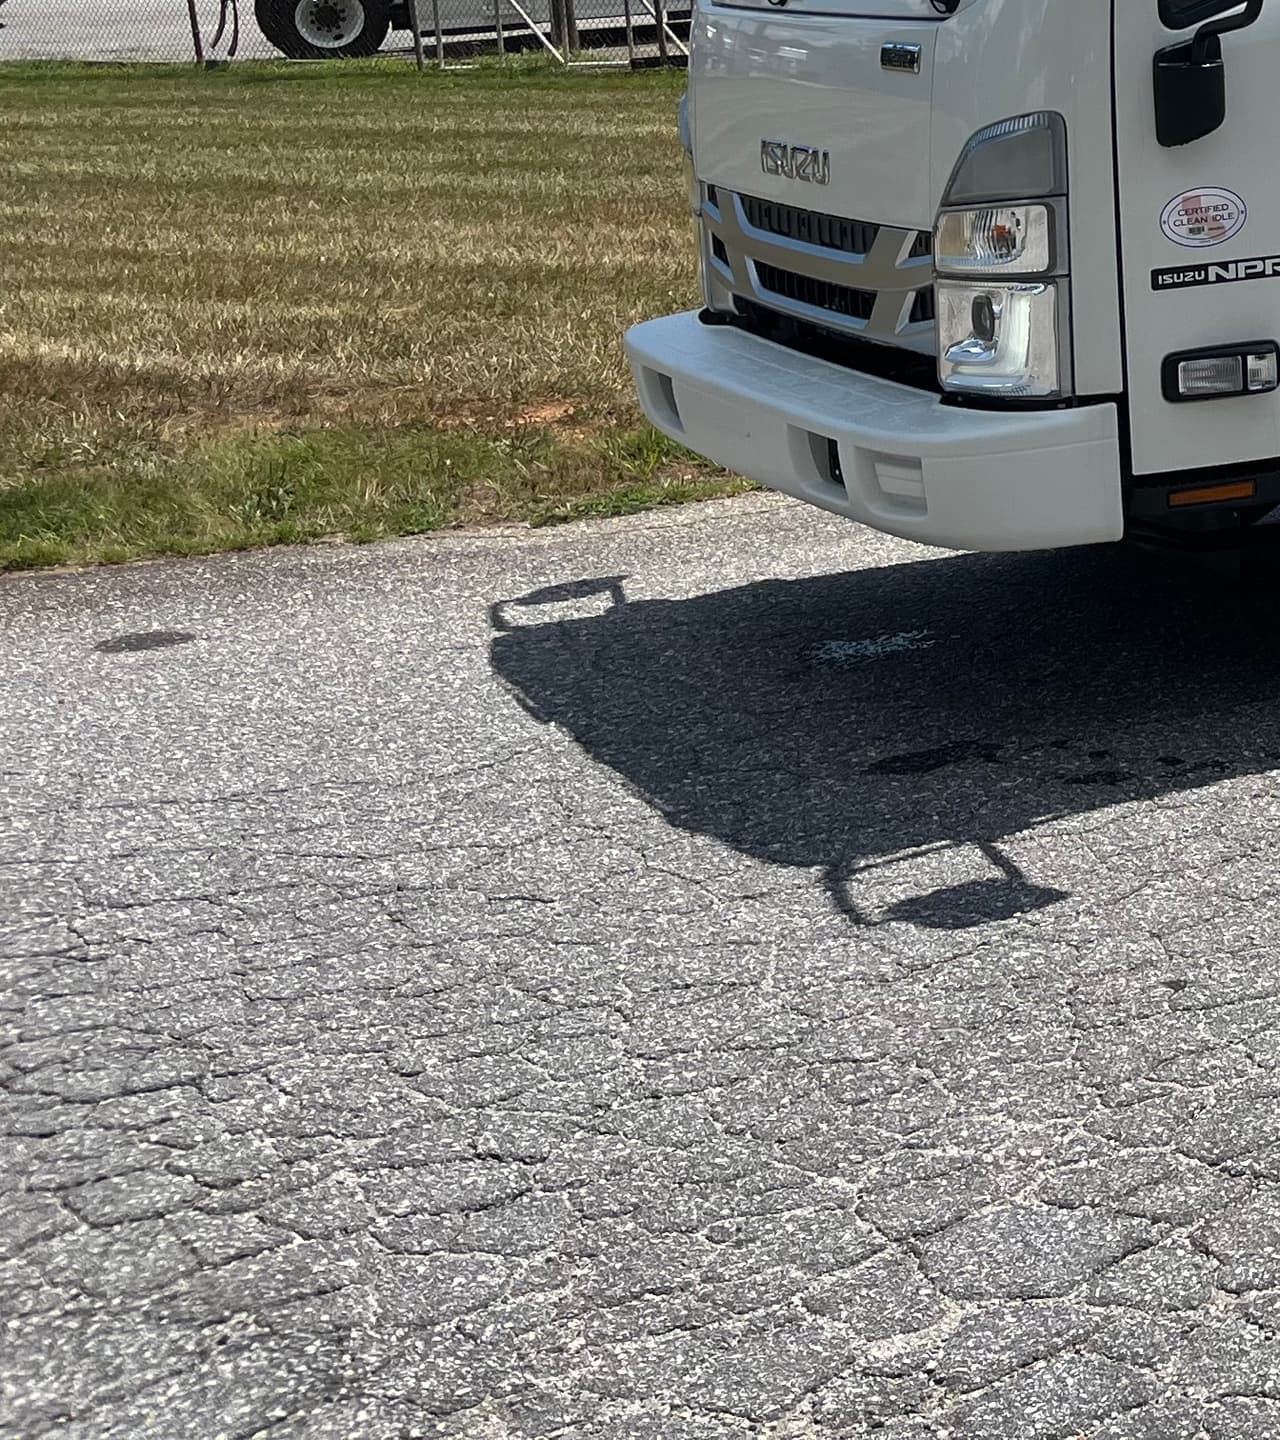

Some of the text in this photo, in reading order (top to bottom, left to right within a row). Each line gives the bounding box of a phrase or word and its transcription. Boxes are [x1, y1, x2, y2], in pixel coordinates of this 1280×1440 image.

[760, 139, 830, 185] ISUZU
[1177, 203, 1229, 217] CERTIFIED
[1173, 215, 1208, 228] CLEAN
[1212, 211, 1235, 223] IDLE
[1158, 269, 1206, 285] ISUZU
